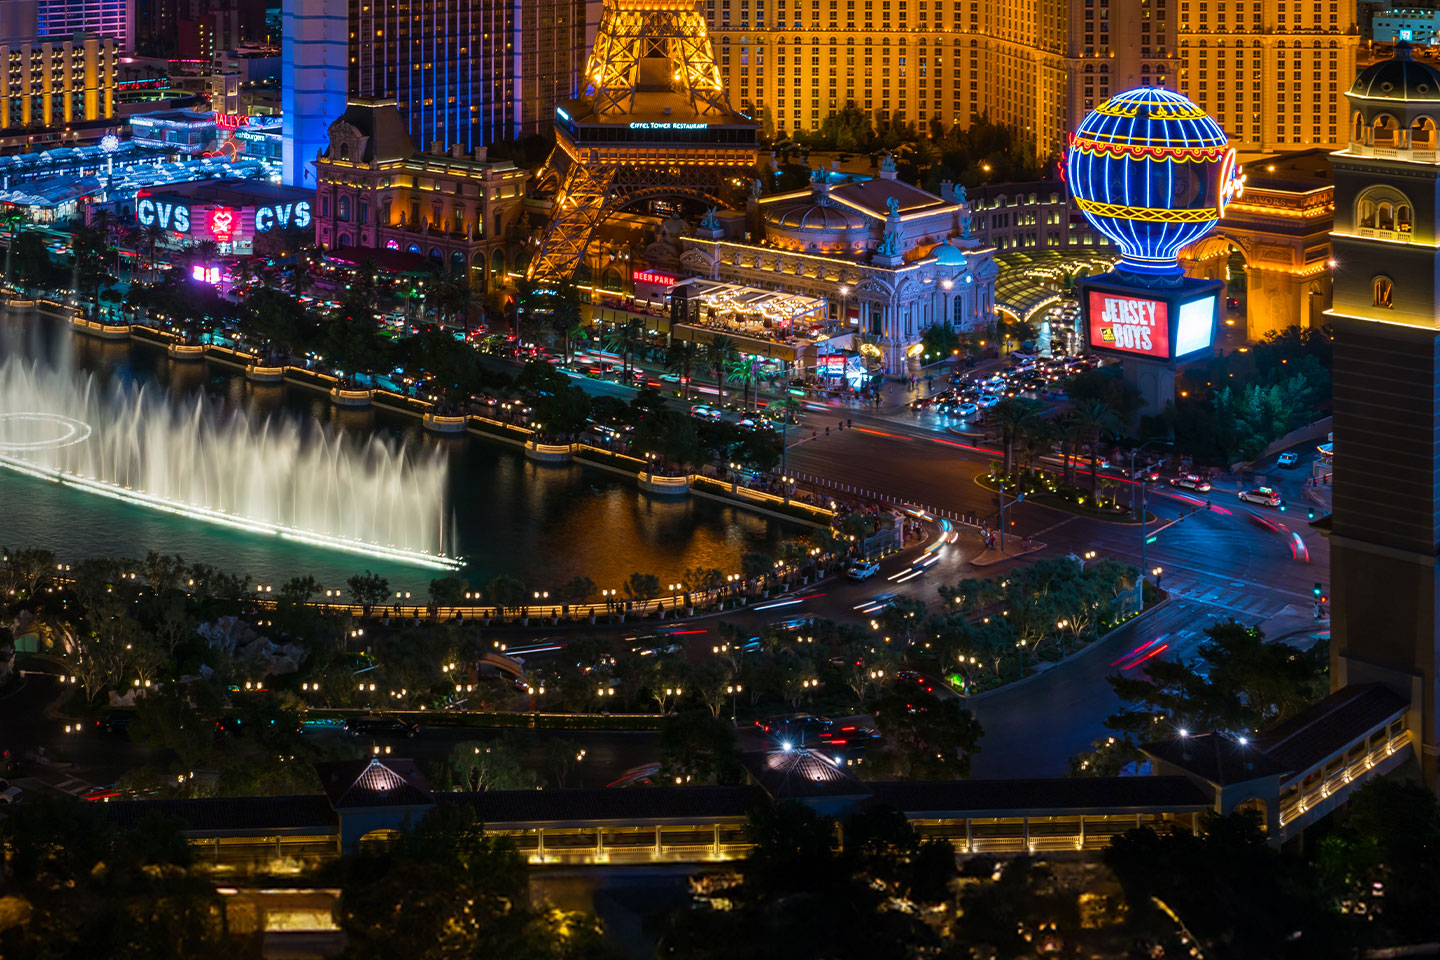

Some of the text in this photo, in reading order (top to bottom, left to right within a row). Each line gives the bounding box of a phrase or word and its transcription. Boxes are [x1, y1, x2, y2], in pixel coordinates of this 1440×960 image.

[138, 199, 191, 233] CVS
[255, 200, 311, 233] CVS
[633, 271, 675, 286] BEER PARK
[1101, 298, 1156, 326] JERSEY
[1112, 323, 1153, 351] BOYS
